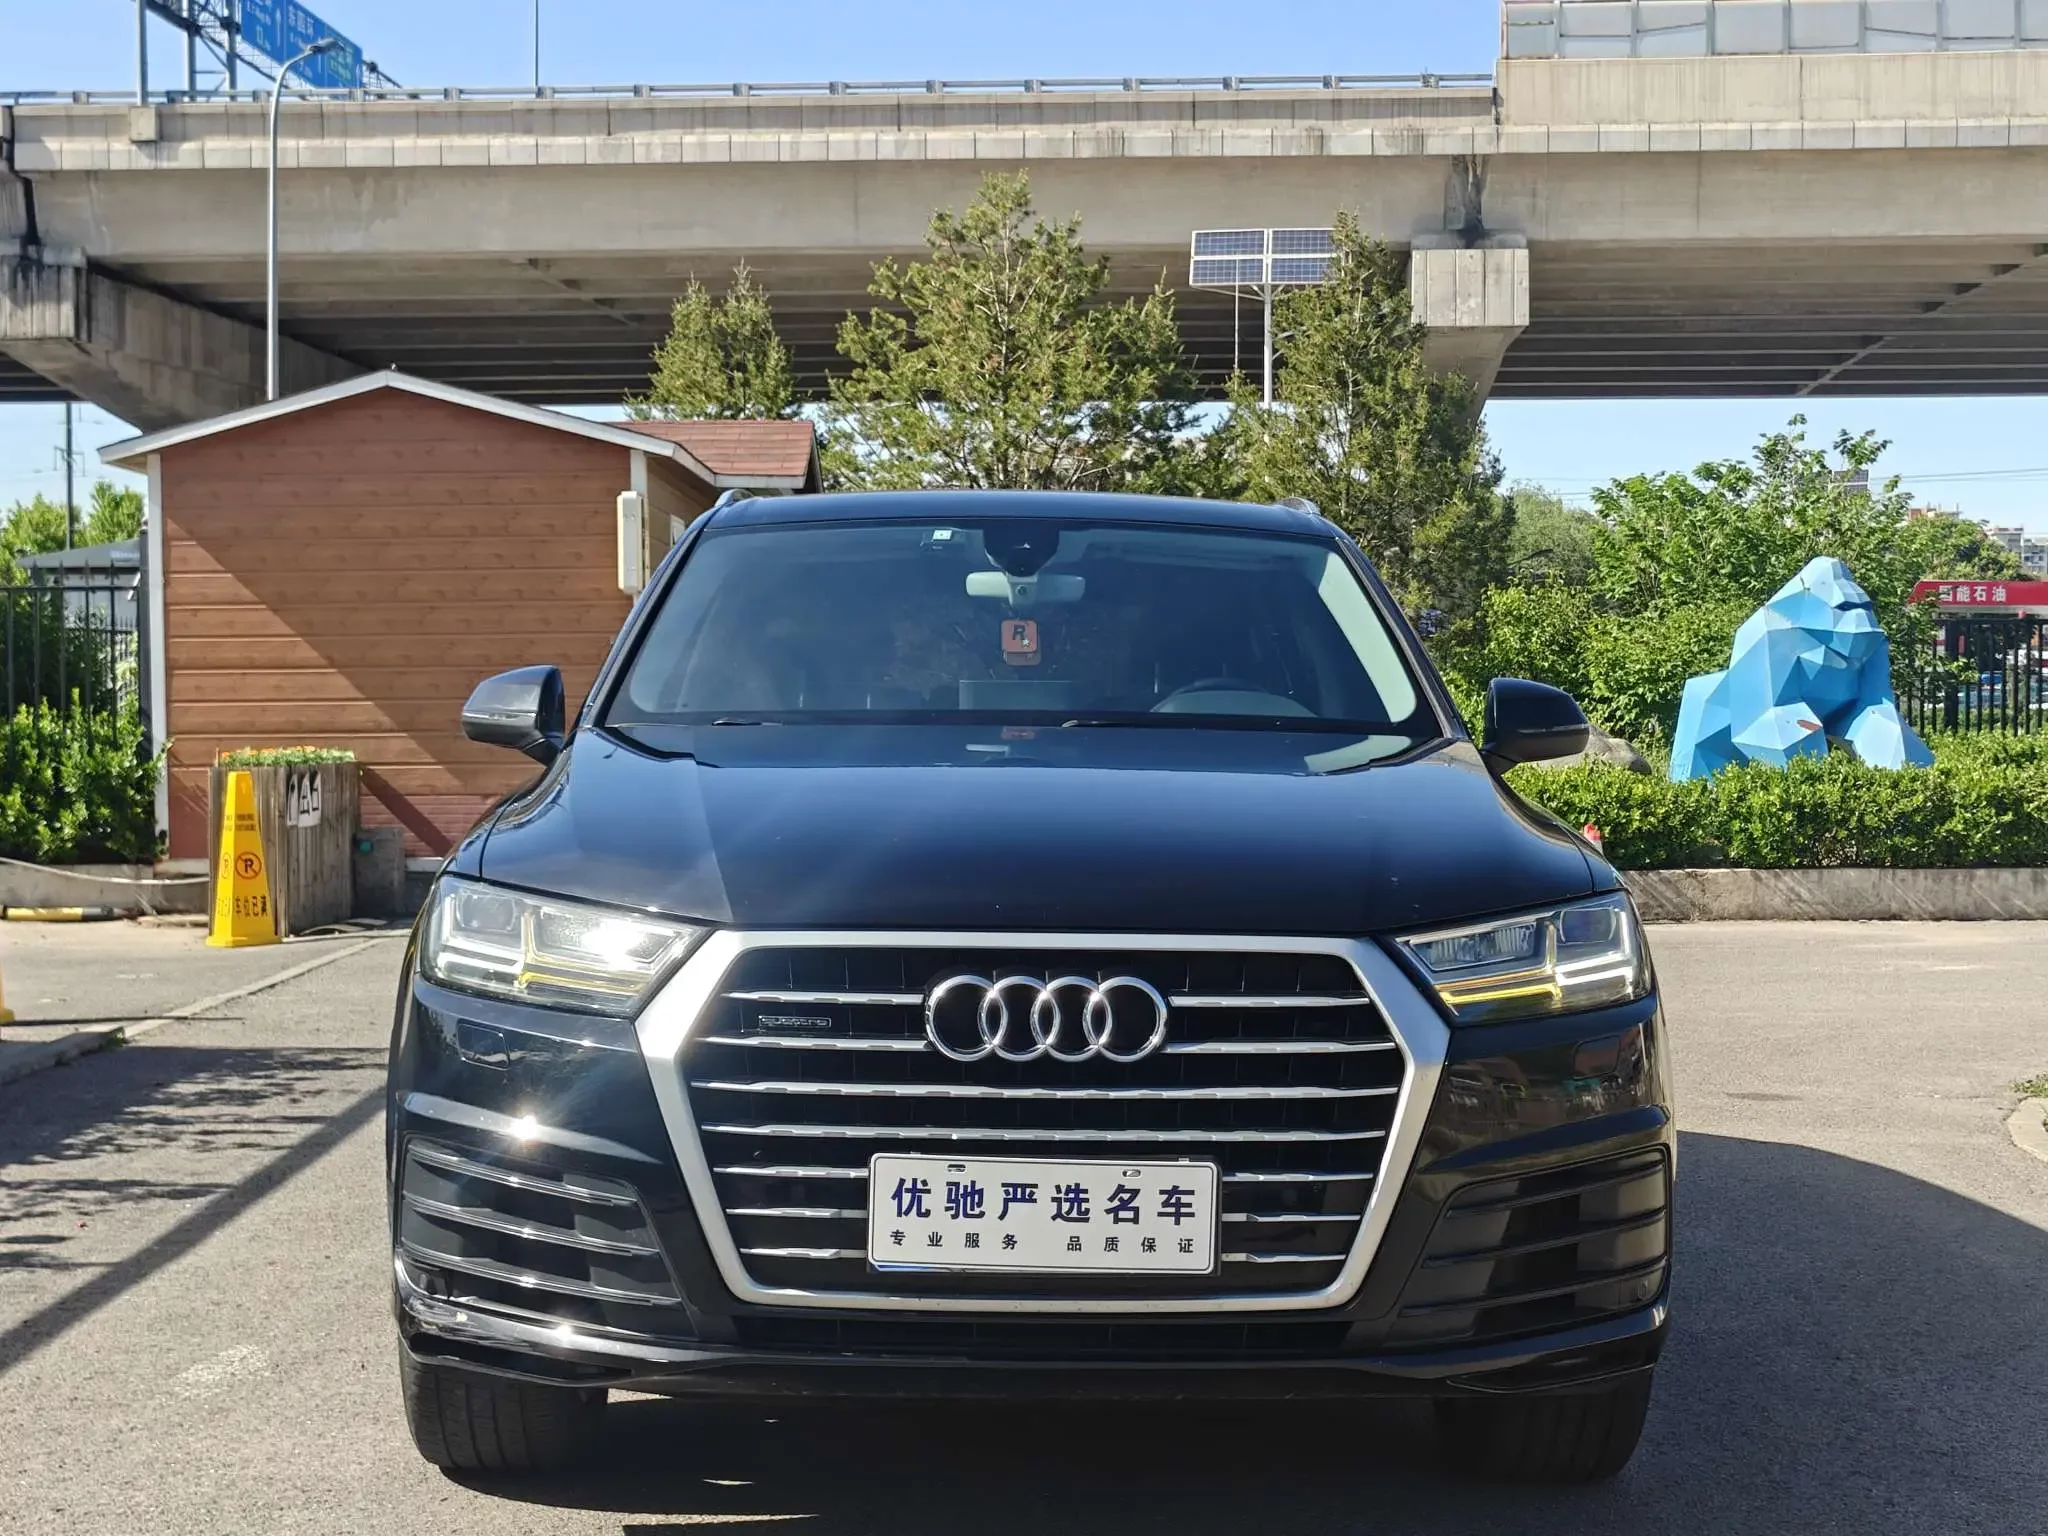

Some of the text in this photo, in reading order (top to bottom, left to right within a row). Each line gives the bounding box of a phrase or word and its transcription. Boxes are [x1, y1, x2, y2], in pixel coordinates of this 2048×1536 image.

[1012, 624, 1027, 641] R
[890, 1176, 1196, 1226] 优驰严选名车
[890, 1228, 1194, 1254] 专业服务 品质保证
